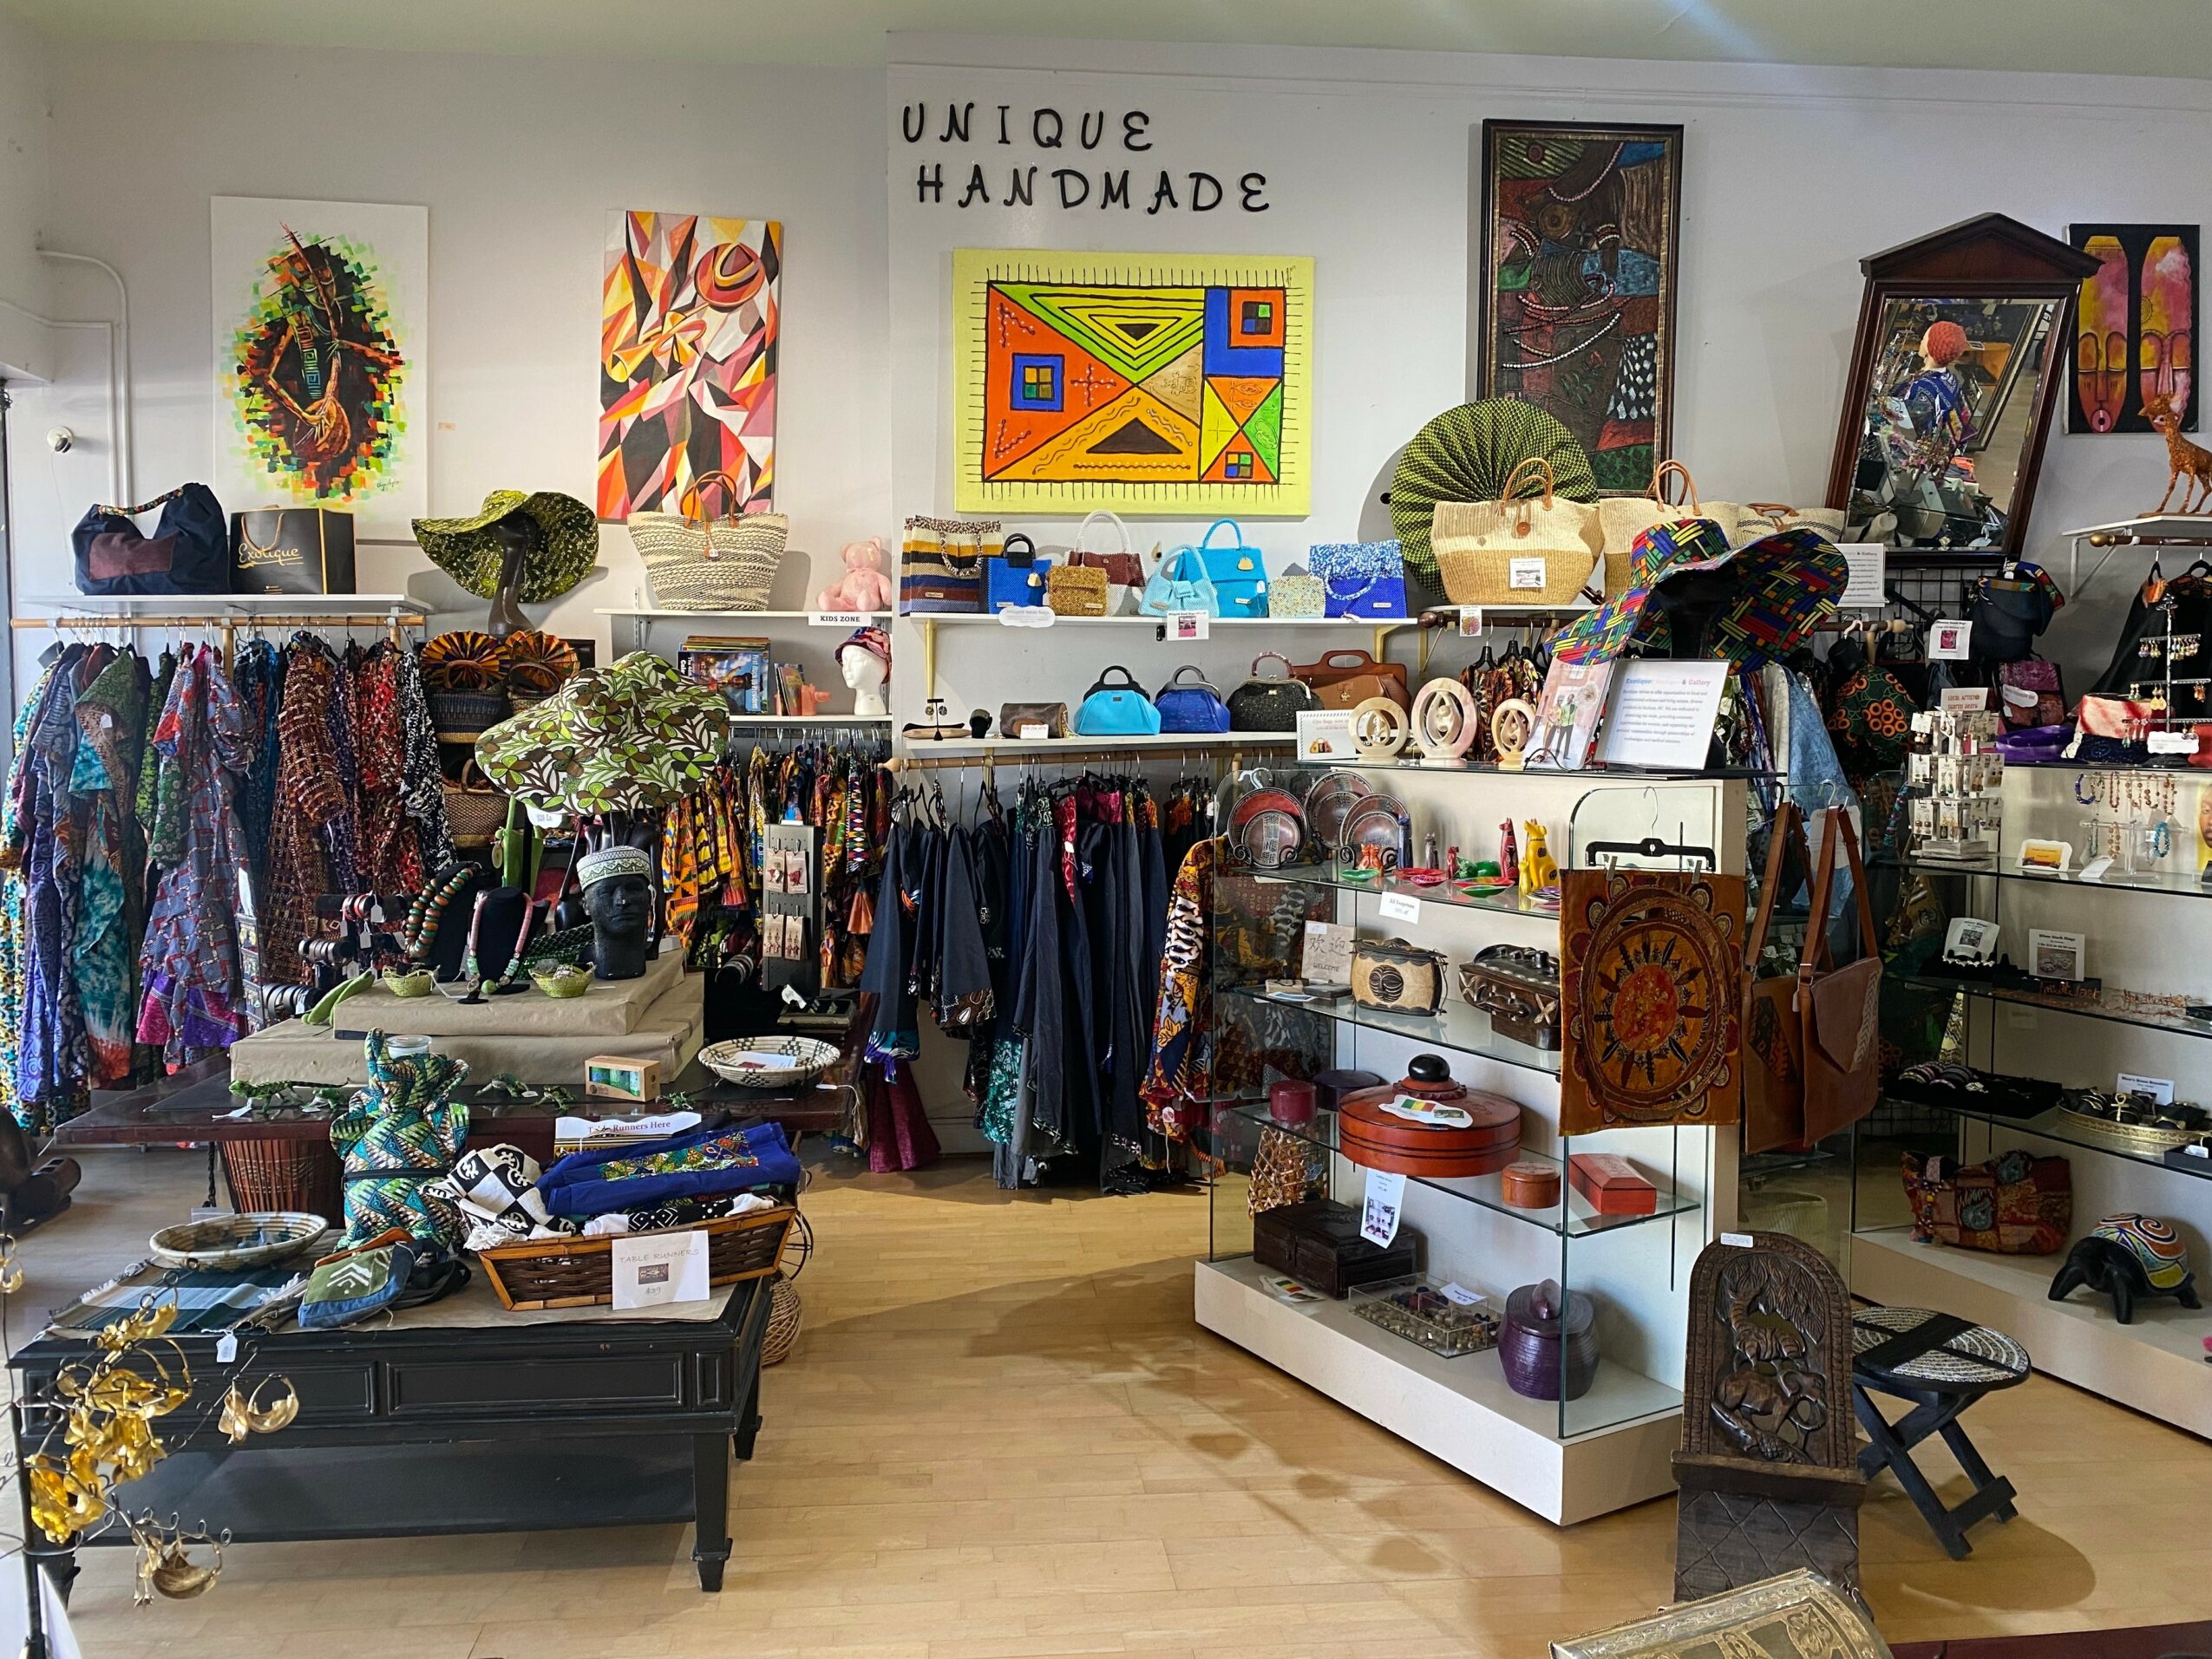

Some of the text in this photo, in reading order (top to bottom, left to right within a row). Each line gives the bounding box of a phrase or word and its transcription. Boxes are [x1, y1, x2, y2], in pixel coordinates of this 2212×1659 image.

[902, 102, 1153, 152] UNIQUE
[917, 163, 1270, 215] HANDMADE
[238, 543, 301, 566] Exotique
[1312, 962, 1340, 972] WELCOME
[612, 1123, 649, 1133] Runners
[619, 1249, 700, 1264] TABLE RUNNERS
